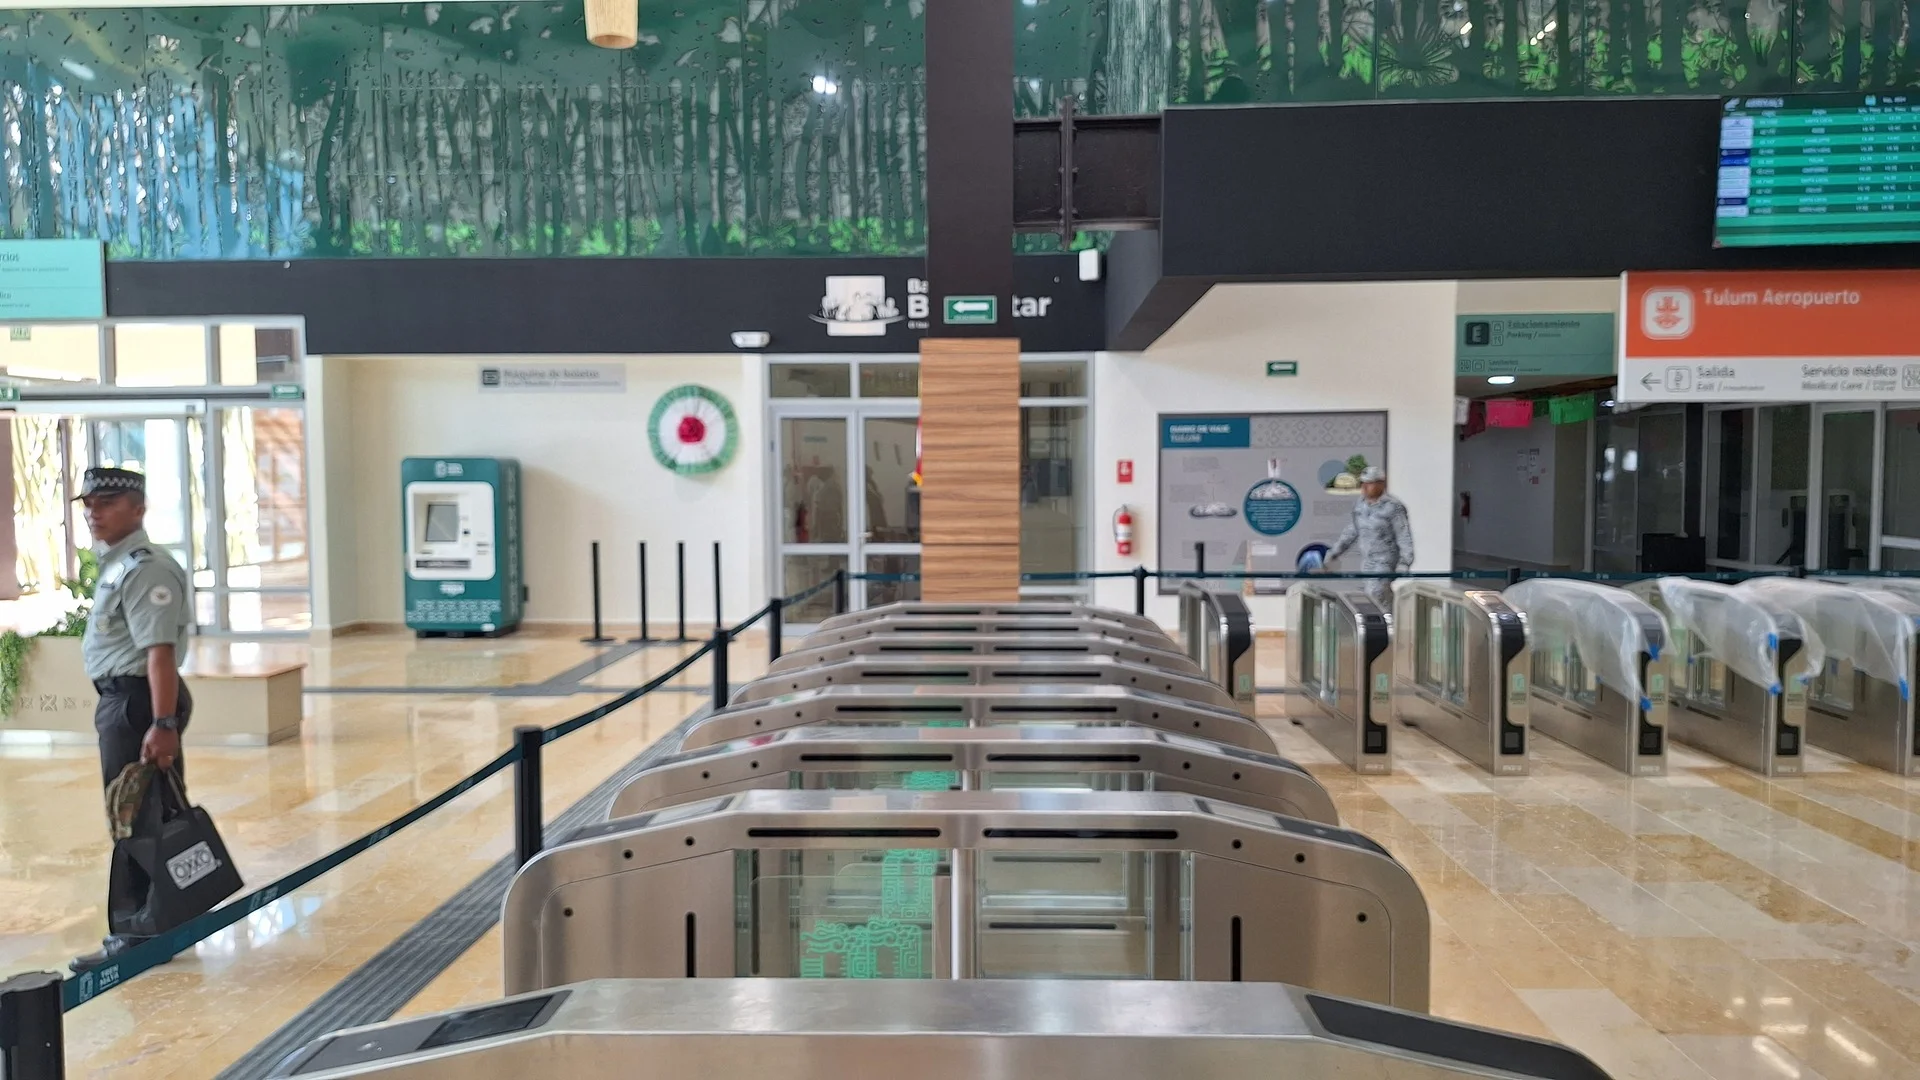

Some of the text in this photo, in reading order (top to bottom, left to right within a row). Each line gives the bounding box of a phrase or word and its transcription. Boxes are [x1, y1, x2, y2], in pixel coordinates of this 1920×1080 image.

[907, 294, 930, 319] B
[1703, 287, 1860, 309] Tulum Aeropuerto
[1471, 325, 1482, 343] E
[1697, 365, 1736, 378] Salida
[1801, 362, 1898, 378] Servicio médico
